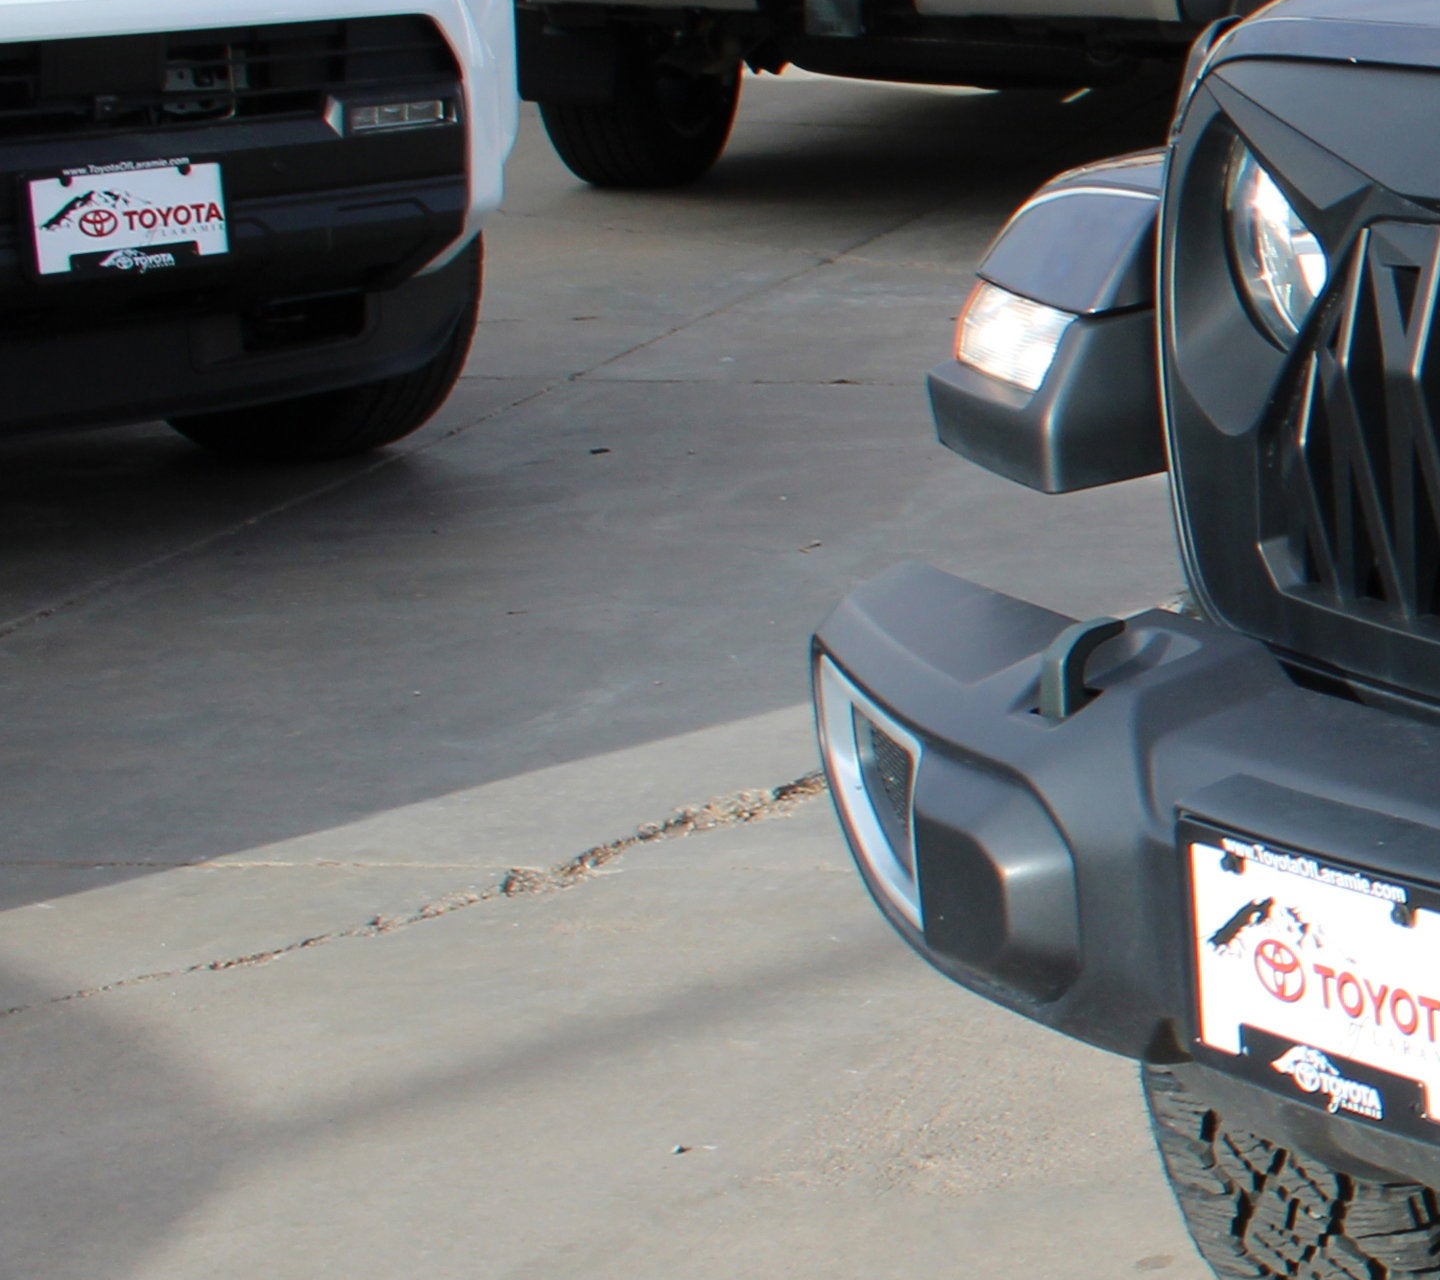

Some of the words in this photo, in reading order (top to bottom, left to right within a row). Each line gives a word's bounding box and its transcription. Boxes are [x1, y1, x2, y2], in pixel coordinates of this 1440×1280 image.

[123, 202, 224, 231] TOYOTA
[1220, 837, 1408, 904] www.ToyotaOfLaramie.com
[1319, 1071, 1383, 1110] TOYOTA
